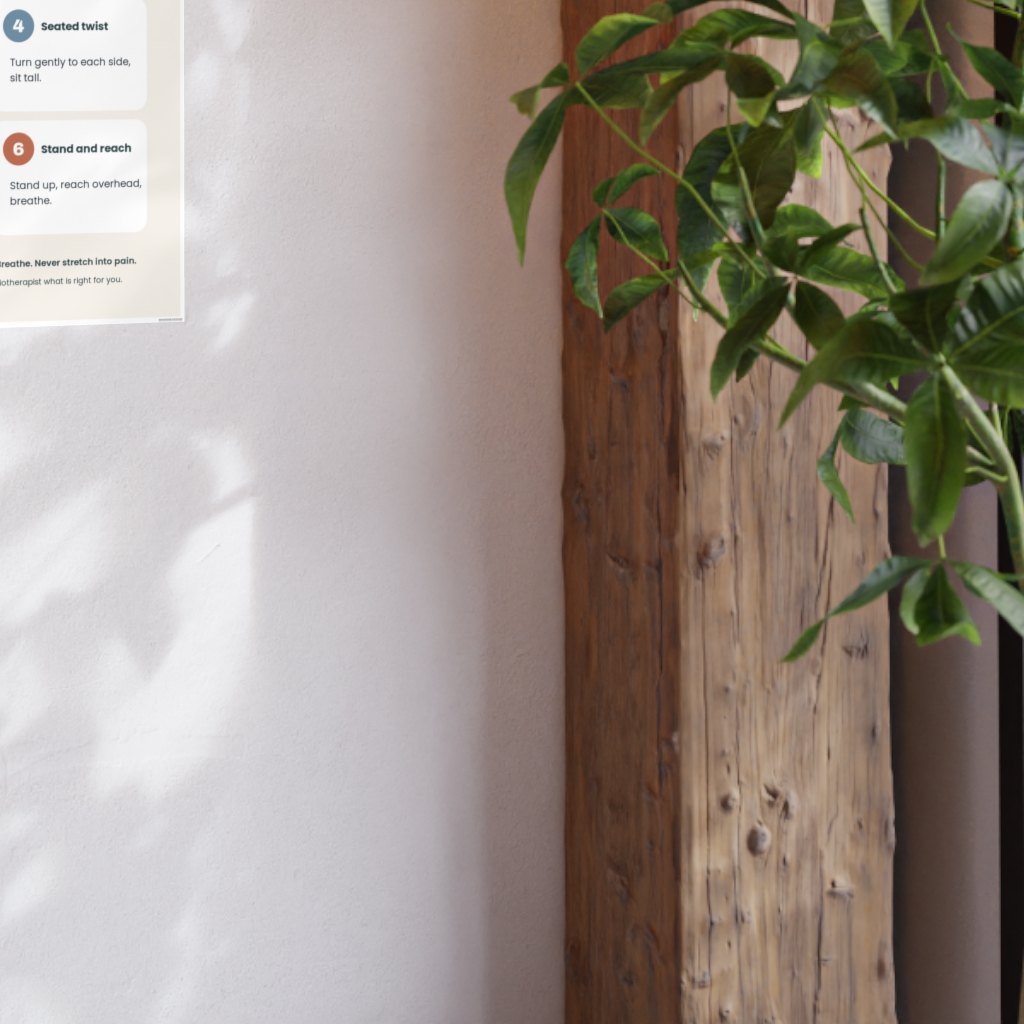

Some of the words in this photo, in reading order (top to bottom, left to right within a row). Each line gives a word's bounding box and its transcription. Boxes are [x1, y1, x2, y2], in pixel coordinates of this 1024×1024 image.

[12, 18, 25, 33] 4
[41, 21, 80, 31] Seated
[81, 20, 109, 31] twist
[9, 57, 32, 67] Turn
[34, 57, 66, 70] gently
[68, 57, 79, 67] to
[80, 57, 106, 67] each
[108, 56, 131, 67] side,
[9, 73, 22, 83] sit
[23, 73, 42, 83] tall.
[12, 142, 25, 156] 6
[41, 143, 74, 154] Stand
[75, 143, 98, 154] and
[99, 143, 132, 153] reach
[9, 180, 40, 190] Stand
[42, 181, 58, 192] up,
[60, 179, 90, 189] reach
[91, 178, 142, 189] overhead,
[9, 196, 52, 206] breathe.
[34, 259, 61, 267] Never
[62, 257, 94, 267] stretch
[95, 257, 113, 266] into
[114, 256, 137, 267] pain.
[43, 277, 64, 285] what
[65, 277, 72, 285] is
[73, 276, 92, 287] right
[93, 276, 105, 284] for
[105, 277, 123, 286] you.
